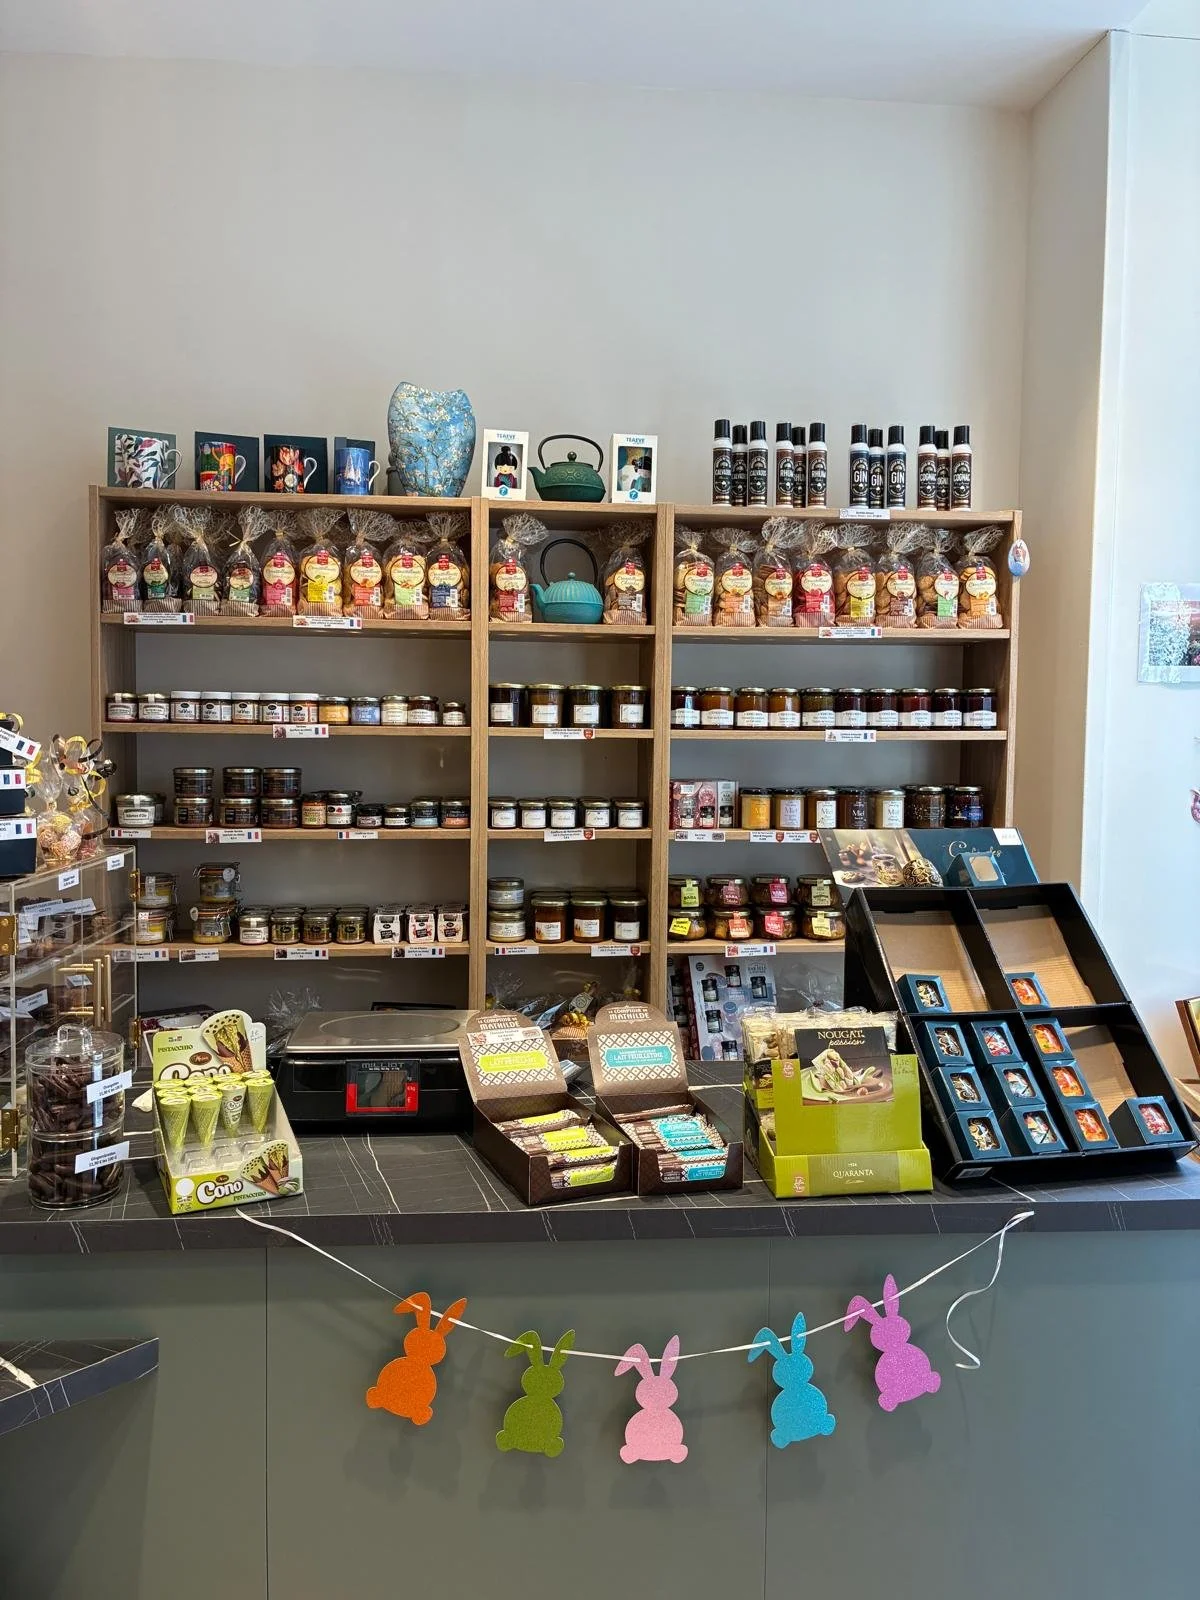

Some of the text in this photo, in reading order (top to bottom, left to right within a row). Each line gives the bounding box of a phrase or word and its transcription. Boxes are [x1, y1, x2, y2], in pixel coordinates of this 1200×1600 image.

[854, 471, 868, 483] GIN
[891, 472, 905, 484] GIN
[480, 1021, 520, 1030] MATHILDE
[818, 1030, 864, 1040] NOUGAT
[828, 1039, 866, 1050] passion
[833, 1168, 874, 1178] QUARANTA
[196, 1180, 243, 1205] Cono
